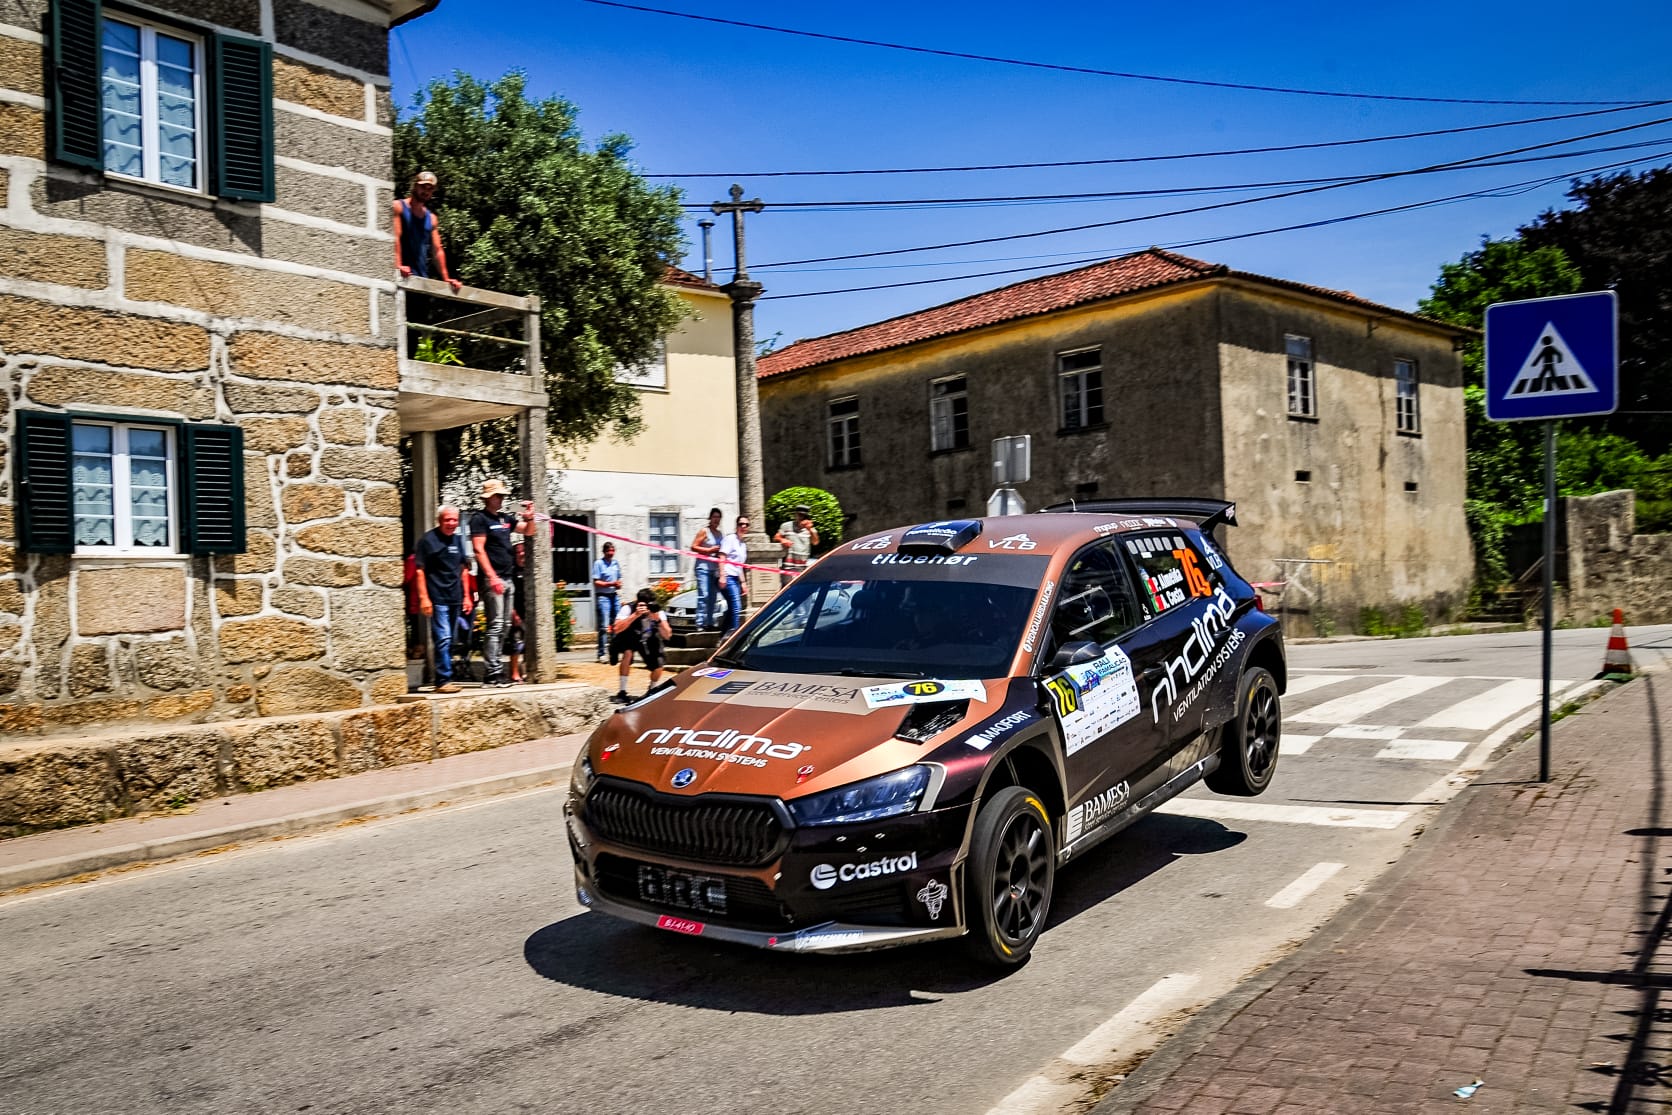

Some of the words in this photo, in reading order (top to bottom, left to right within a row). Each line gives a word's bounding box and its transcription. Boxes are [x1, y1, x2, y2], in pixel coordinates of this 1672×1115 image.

[851, 542, 892, 551] VLB
[871, 553, 978, 566] tilbehør
[988, 540, 1037, 550] VLB
[1172, 548, 1212, 597] 76
[1151, 588, 1236, 724] nhclima
[753, 681, 859, 699] BAMESA
[908, 681, 938, 695] 76
[1173, 661, 1217, 722] VENTILATION
[1215, 628, 1246, 669] SYSTEMS
[1047, 677, 1077, 717] 76
[979, 710, 1032, 740] MAQFORT
[635, 726, 806, 760] nhclima
[650, 746, 715, 761] VENTILATION
[716, 753, 768, 767] SYSTEMS
[1085, 780, 1130, 822] BAMESA
[839, 851, 918, 882] Castrol
